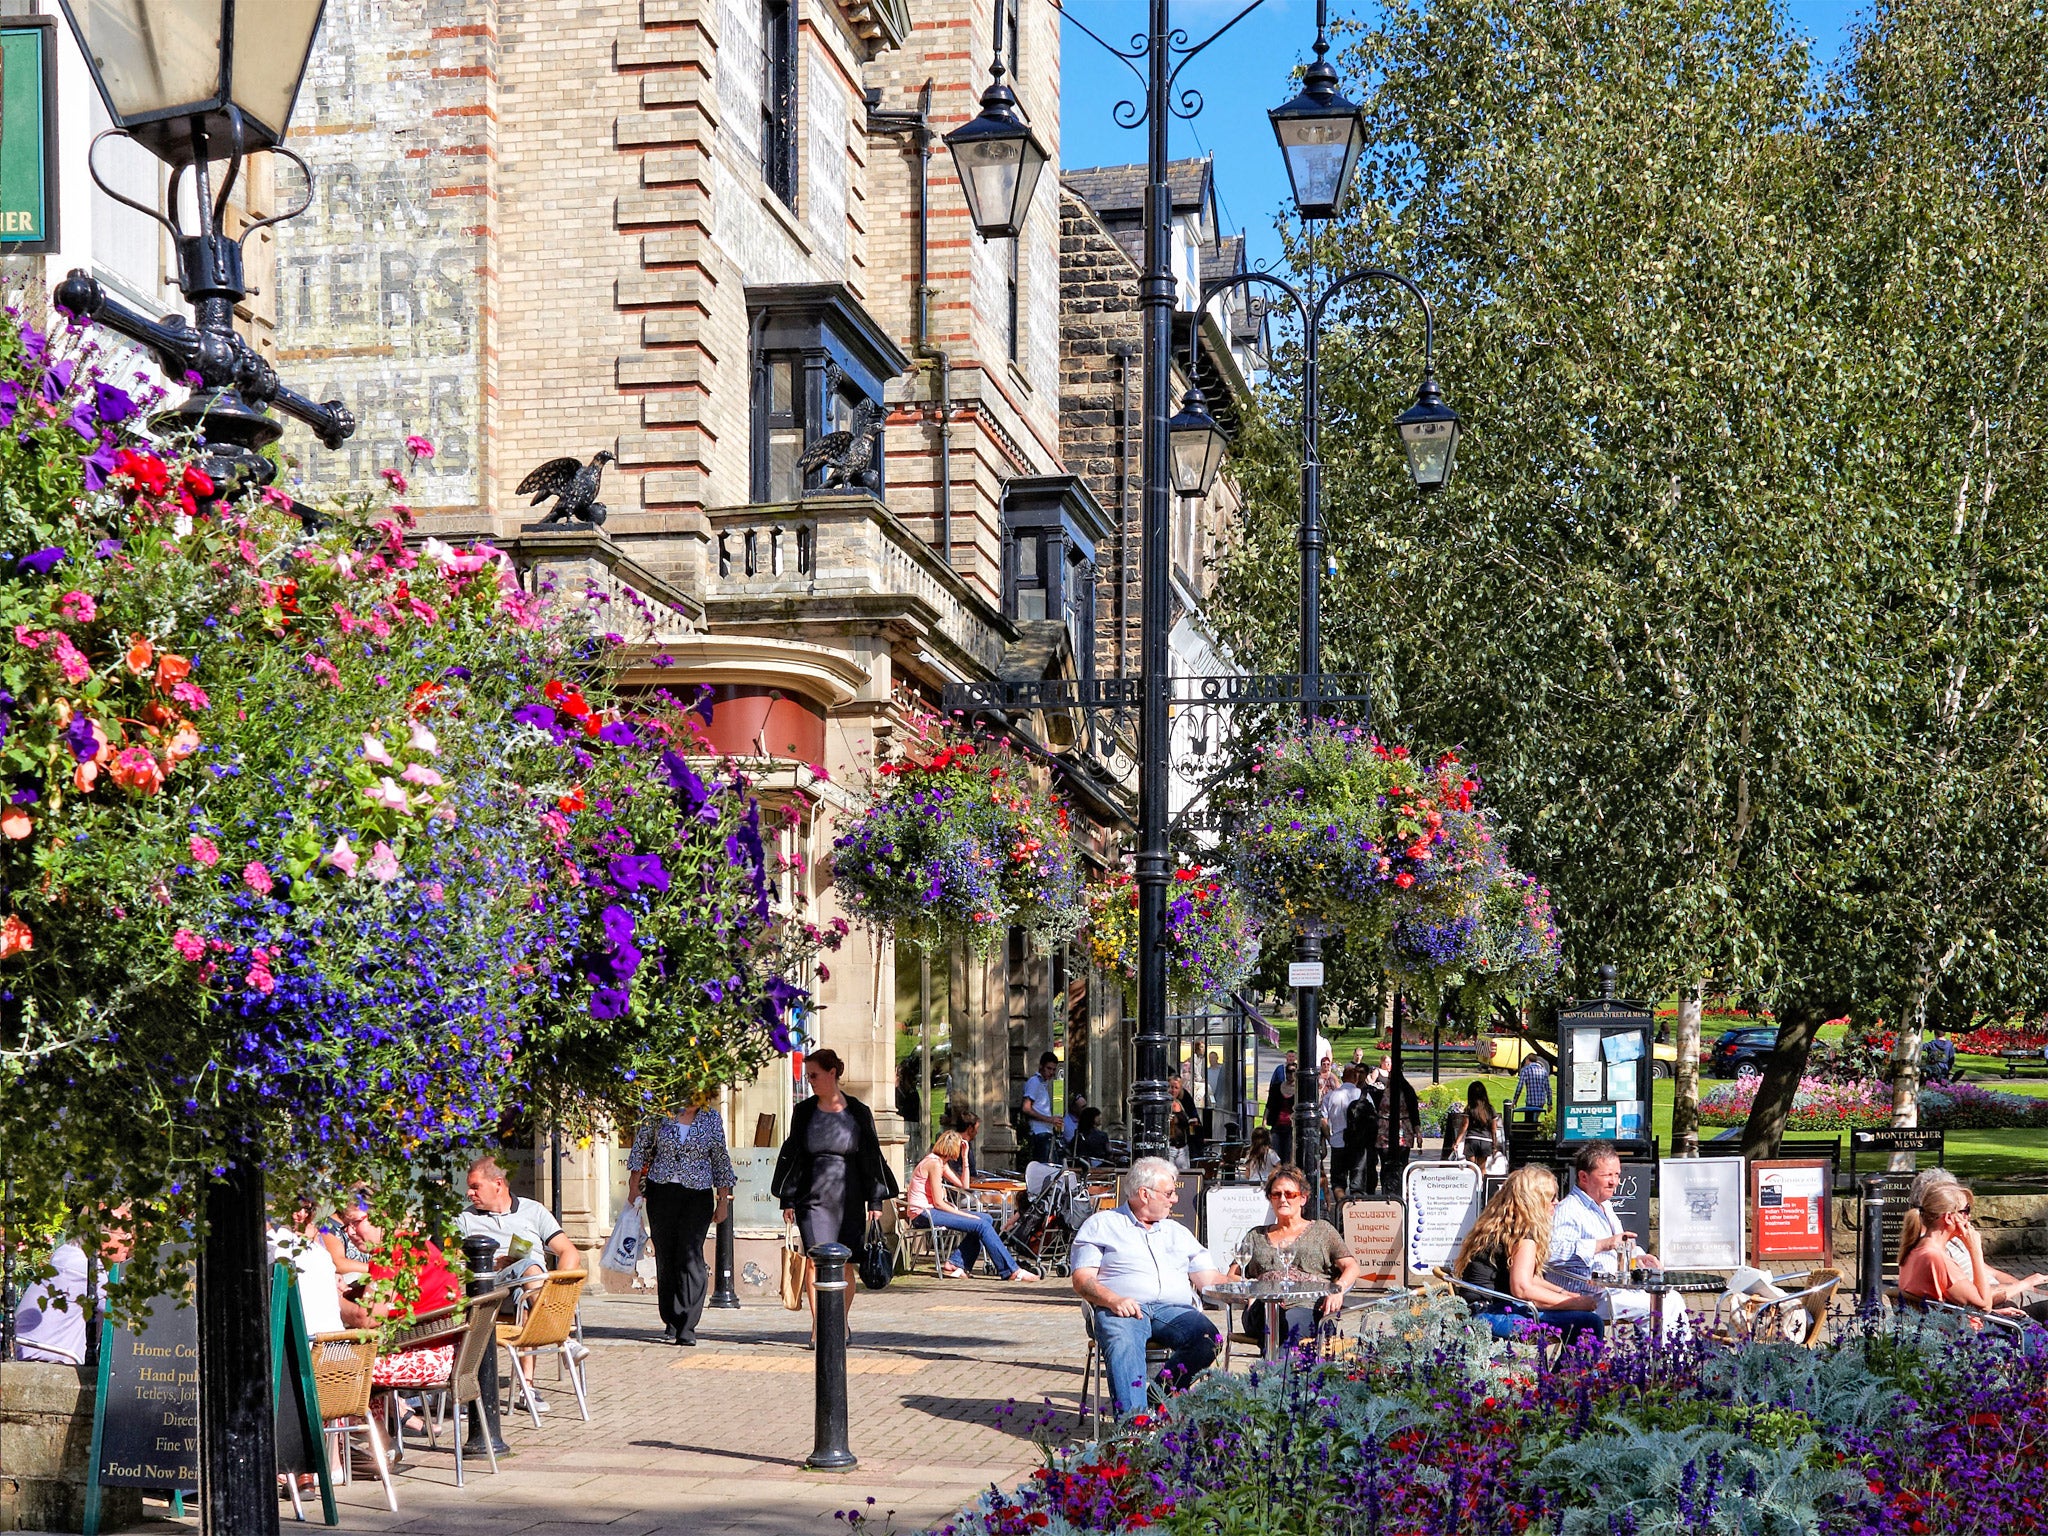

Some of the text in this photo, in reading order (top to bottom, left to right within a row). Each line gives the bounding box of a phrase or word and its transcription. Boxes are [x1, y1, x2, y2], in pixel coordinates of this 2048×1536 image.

[943, 681, 1138, 704] MONTPELLIER
[1200, 676, 1343, 700] QUARTER
[1570, 1107, 1613, 1115] ANTIQUES
[1875, 1130, 1941, 1139] MONTPELLIER
[1894, 1140, 1923, 1148] MEWS
[1349, 1211, 1396, 1219] EXCLUSIVE
[1357, 1223, 1390, 1232] Lingerie
[1353, 1235, 1394, 1244] Nightwear
[1355, 1247, 1395, 1255] Swimwear
[1359, 1259, 1401, 1267] La Femme
[132, 1342, 198, 1358] Home Coo
[139, 1367, 198, 1387] Hand pul
[135, 1385, 198, 1405] Tetleys, Joh
[163, 1411, 198, 1427] Direct
[155, 1437, 198, 1452] Fine W
[108, 1462, 199, 1480] Food Now Bei
